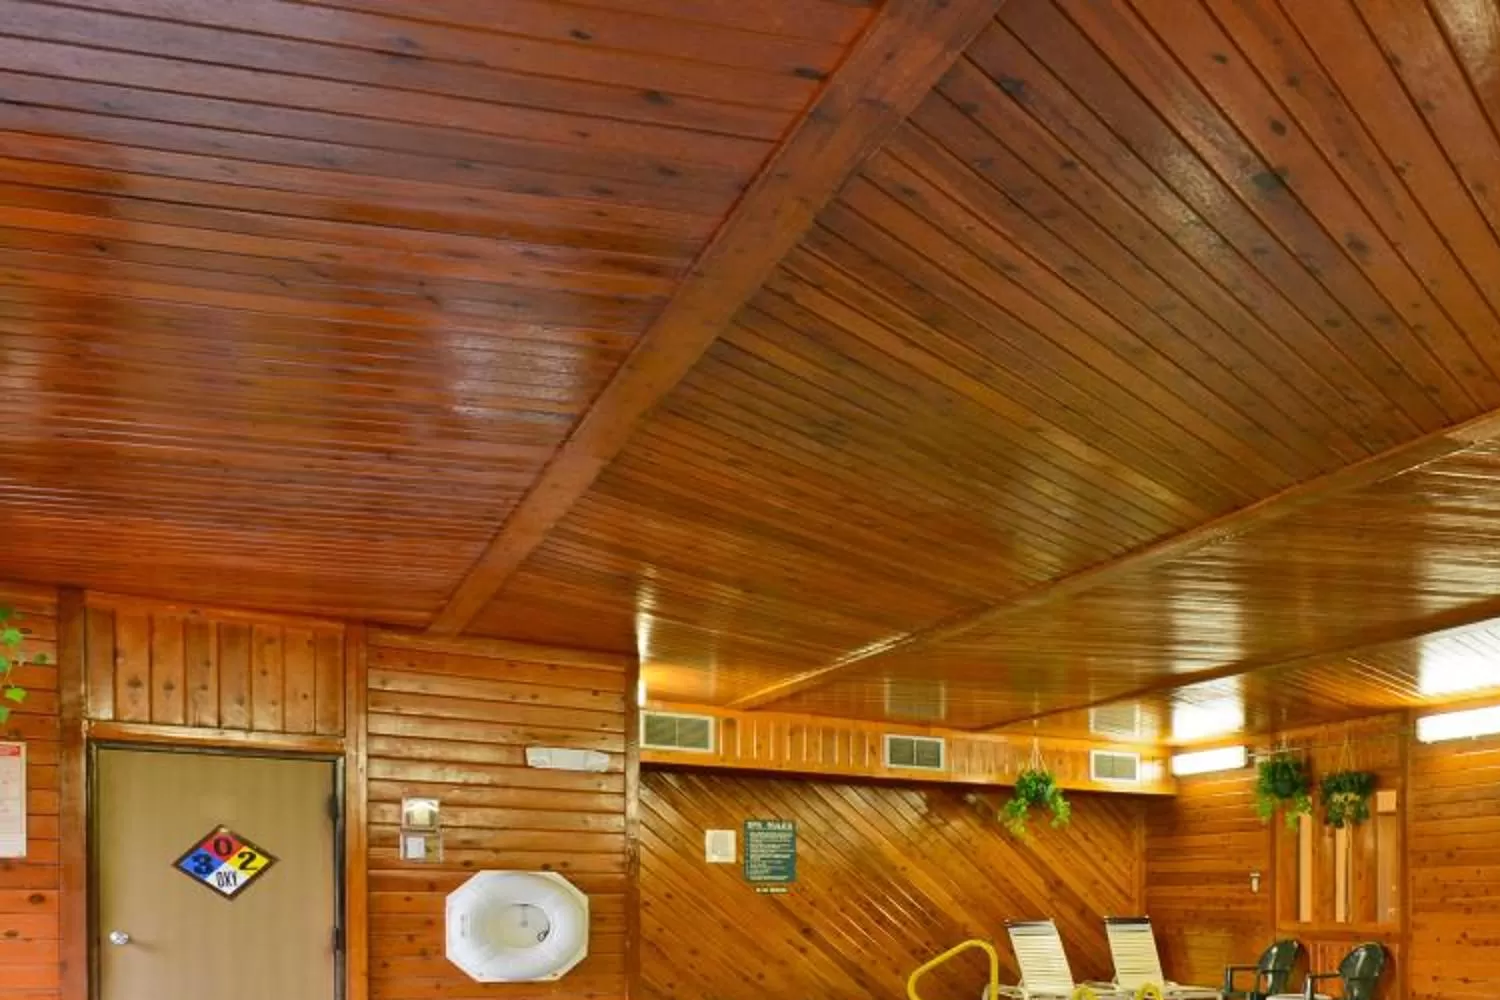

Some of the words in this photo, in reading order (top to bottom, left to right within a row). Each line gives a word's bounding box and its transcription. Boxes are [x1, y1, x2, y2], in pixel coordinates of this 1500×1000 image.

[213, 836, 233, 857] 0
[192, 853, 215, 876] 3
[238, 851, 258, 871] 2
